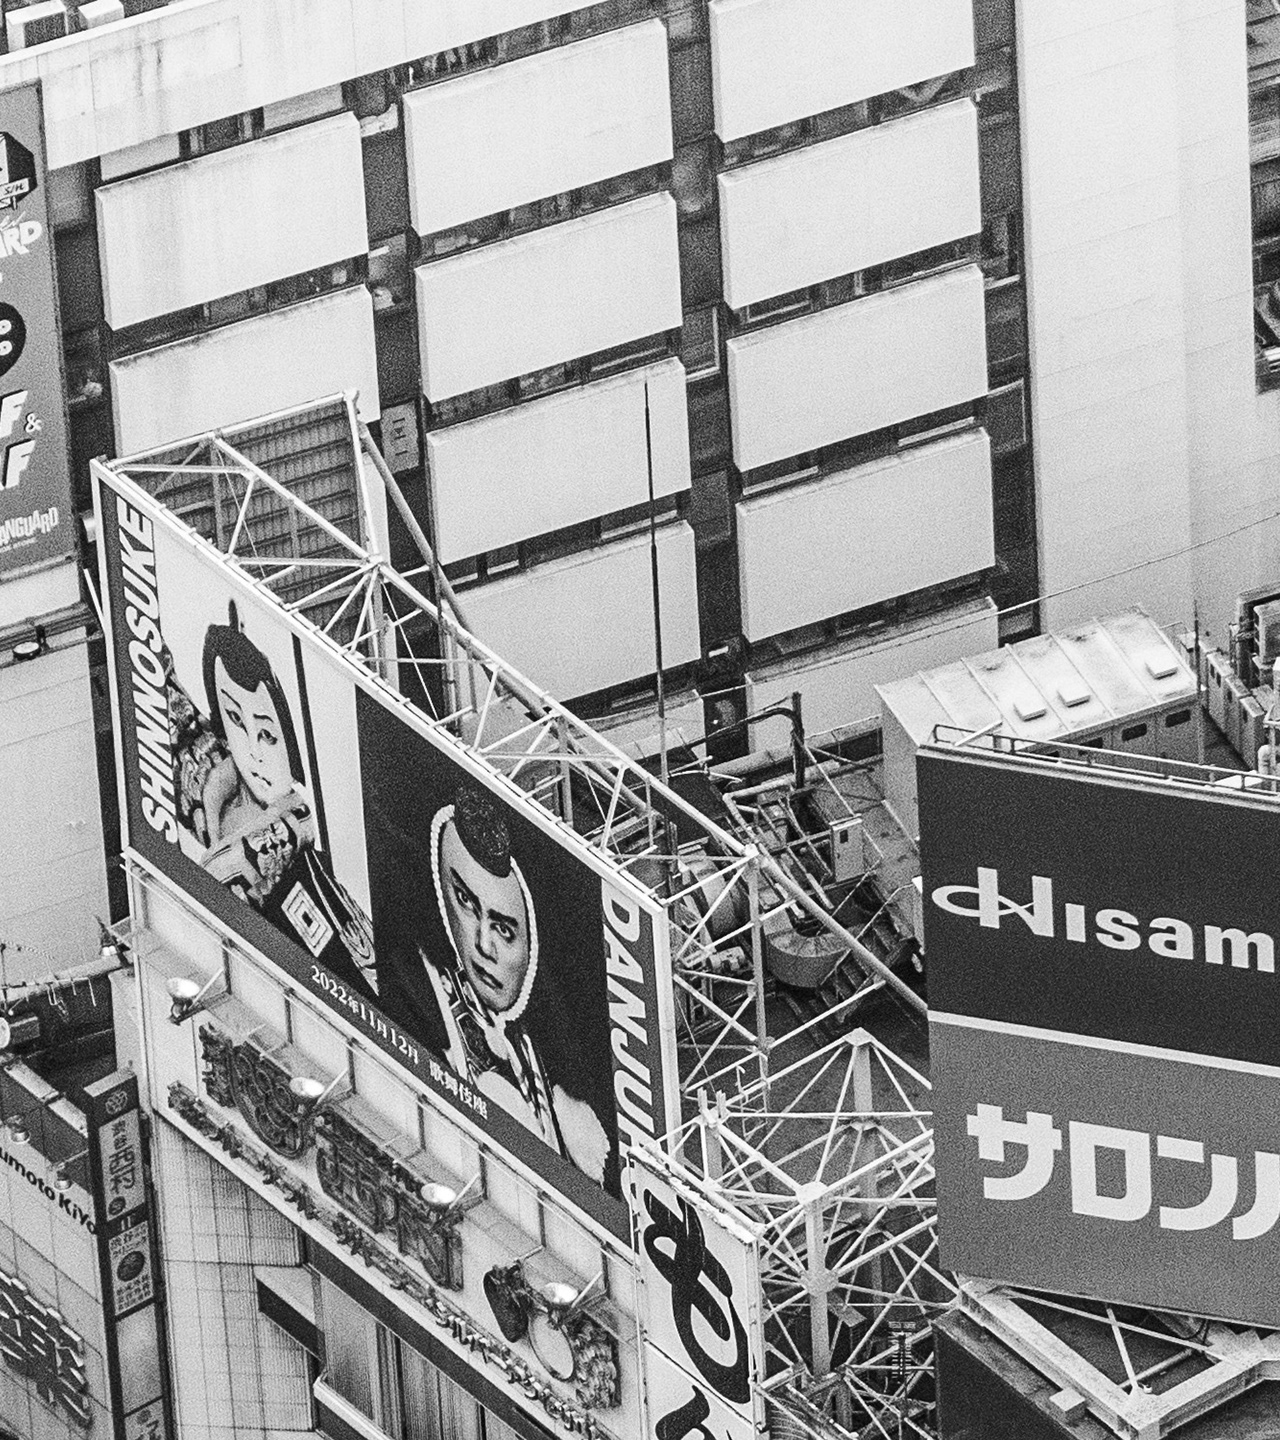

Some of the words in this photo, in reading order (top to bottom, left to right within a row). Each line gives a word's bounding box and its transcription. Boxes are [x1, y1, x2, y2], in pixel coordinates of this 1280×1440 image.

[120, 497, 178, 844] SHINNOSUKE
[602, 897, 666, 1165] DANJU
[58, 1192, 97, 1235] KiYo
